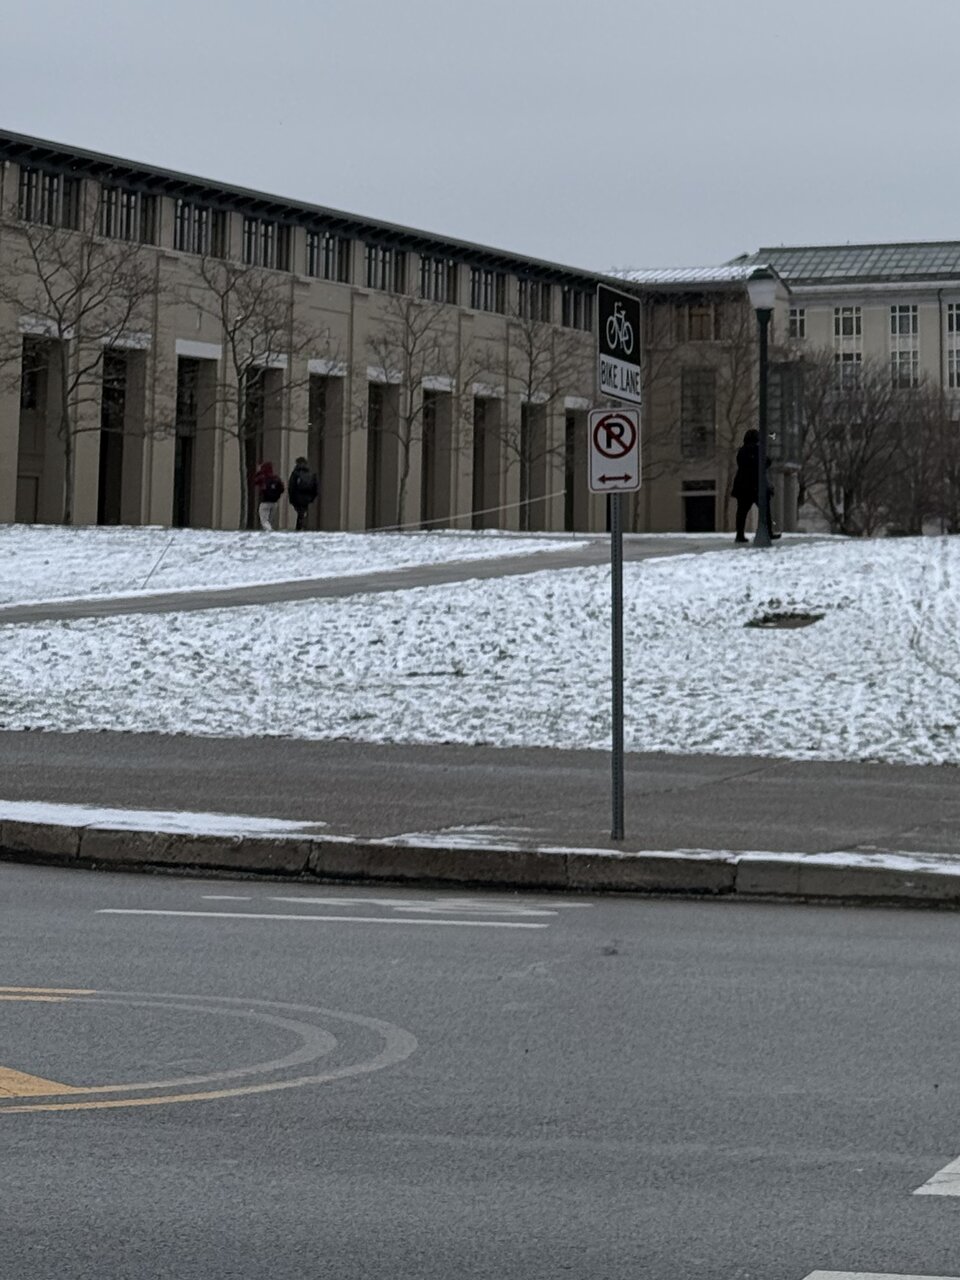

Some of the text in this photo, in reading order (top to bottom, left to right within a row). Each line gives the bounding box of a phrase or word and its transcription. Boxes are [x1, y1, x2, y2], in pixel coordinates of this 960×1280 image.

[601, 360, 640, 396] BIKE LANE
[606, 422, 625, 449] P
